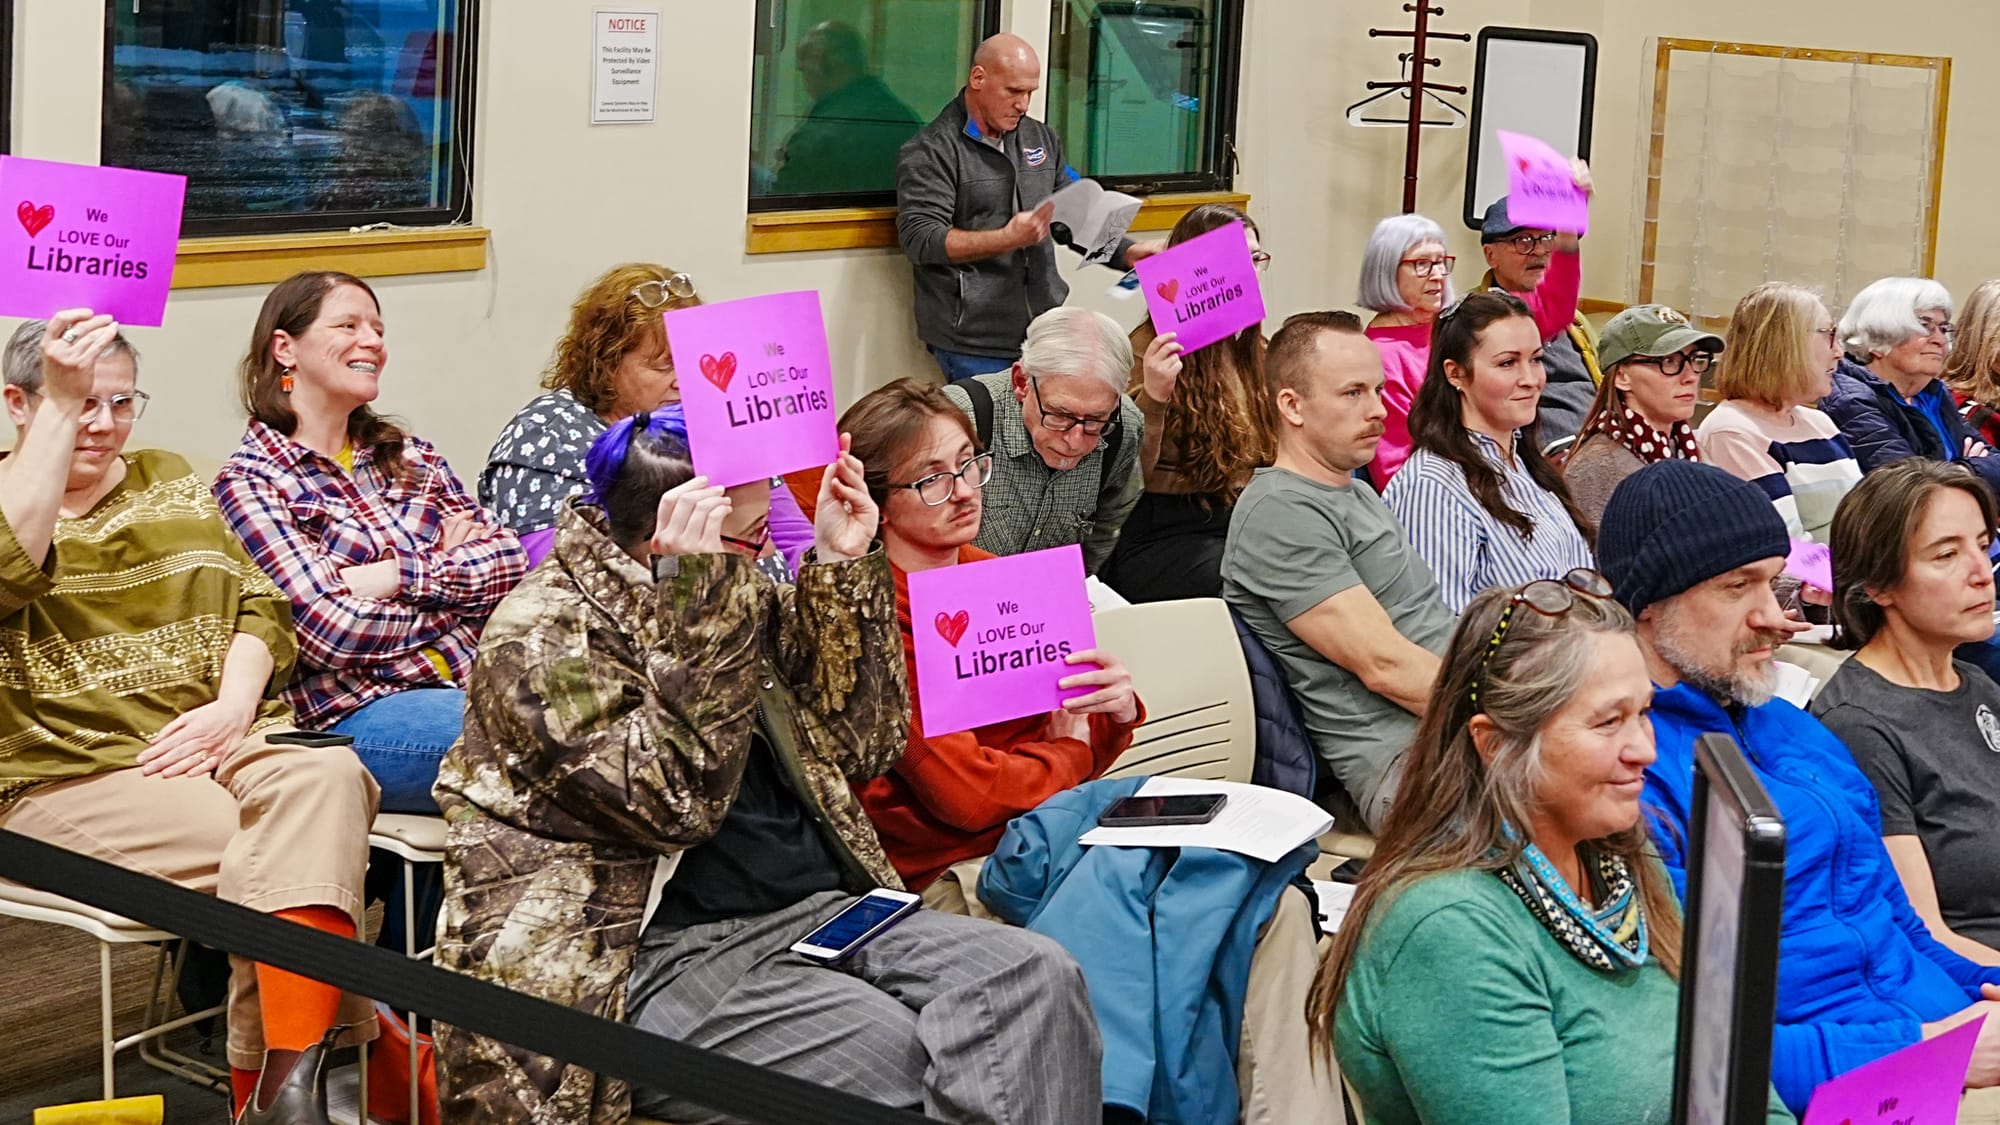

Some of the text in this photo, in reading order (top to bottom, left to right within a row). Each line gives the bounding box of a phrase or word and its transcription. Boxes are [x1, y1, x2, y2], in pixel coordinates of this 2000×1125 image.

[608, 19, 646, 32] NOTICE
[613, 46, 632, 54] Facility
[629, 57, 635, 65] By
[636, 57, 651, 65] Video
[612, 78, 640, 86] Equipment
[86, 207, 109, 223] We
[58, 230, 130, 249] LOVE Our
[27, 245, 148, 280] Libraries
[1194, 267, 1208, 278] We
[1185, 277, 1226, 298] LOVE Our
[1175, 284, 1243, 323] Libraries
[763, 342, 785, 358] We
[747, 366, 808, 389] LOVE Our
[726, 385, 828, 428] Libraries
[997, 601, 1020, 616] We
[977, 621, 1046, 645] LOVE Our
[954, 639, 1073, 680] Libraries
[1878, 1097, 1898, 1116] We
